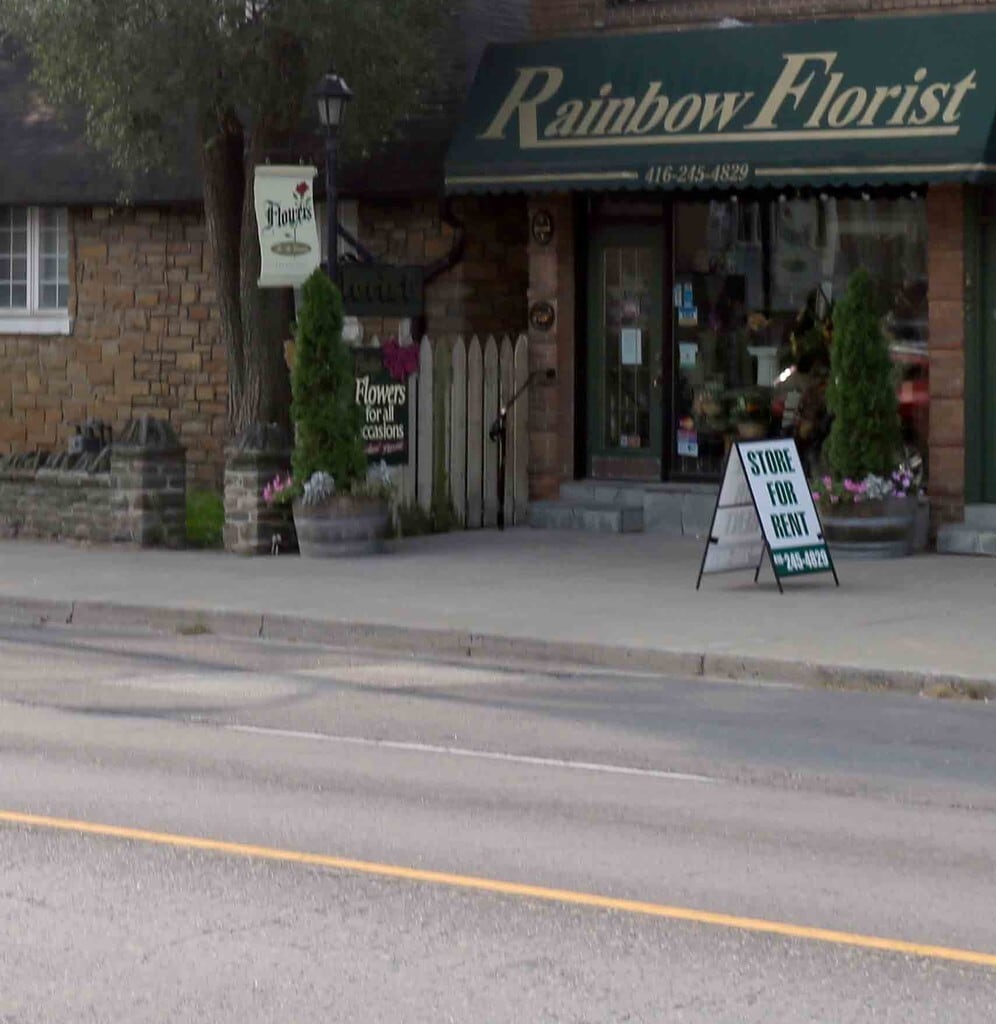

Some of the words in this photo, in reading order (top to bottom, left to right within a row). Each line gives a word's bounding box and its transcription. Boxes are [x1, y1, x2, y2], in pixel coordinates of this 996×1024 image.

[477, 66, 754, 148] Rainbow
[744, 51, 978, 131] Florist
[644, 162, 750, 185] 416-245-4829
[355, 375, 406, 406] Flowers
[365, 404, 382, 423] for
[382, 403, 395, 423] all
[360, 422, 405, 440] ccasions
[747, 448, 796, 476] STORE
[766, 479, 798, 507] FOR
[770, 511, 810, 539] RENT
